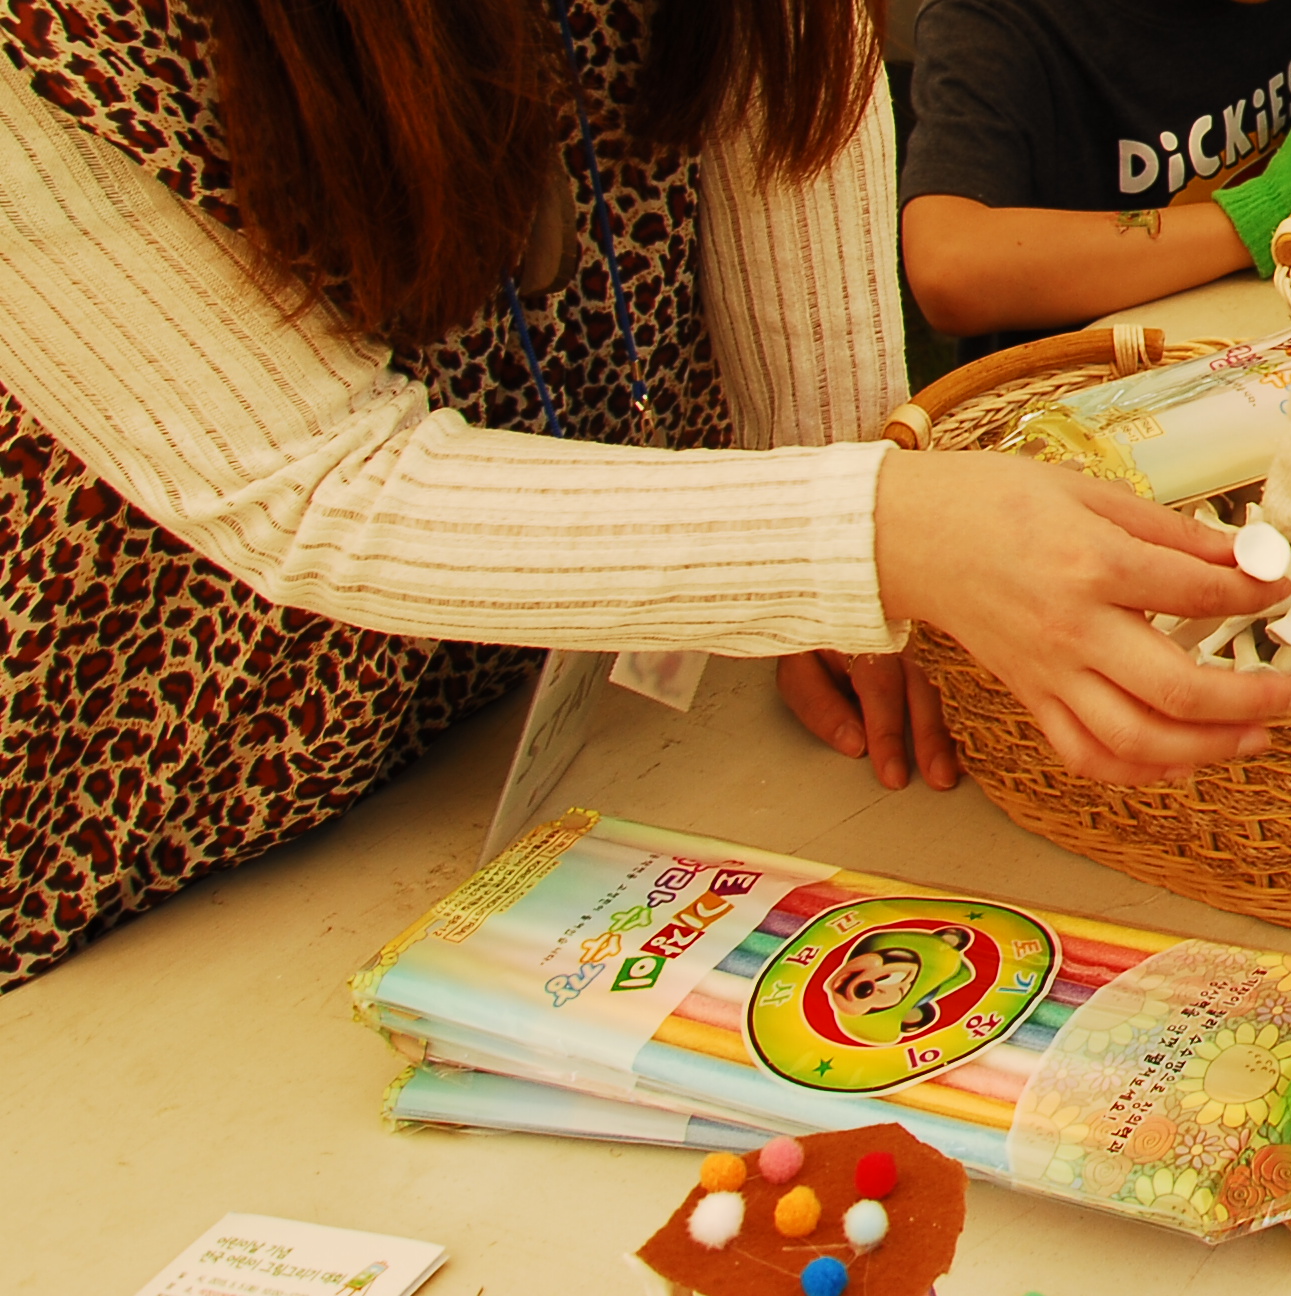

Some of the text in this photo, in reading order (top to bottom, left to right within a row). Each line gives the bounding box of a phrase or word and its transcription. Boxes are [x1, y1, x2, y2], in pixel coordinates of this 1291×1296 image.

[613, 870, 762, 991] 토기장이
[761, 910, 860, 1007] 고려사
[904, 939, 1042, 1070] 토기장이
[1180, 981, 1229, 1019] 상상력을
[1222, 968, 1268, 1007] 토기장이
[1103, 1052, 1166, 1122] 펼쳐보세요!
[1149, 1033, 1203, 1093] 수수깡으로
[1106, 1101, 1153, 1153] 창의력과
[225, 1254, 262, 1271] 어린이
